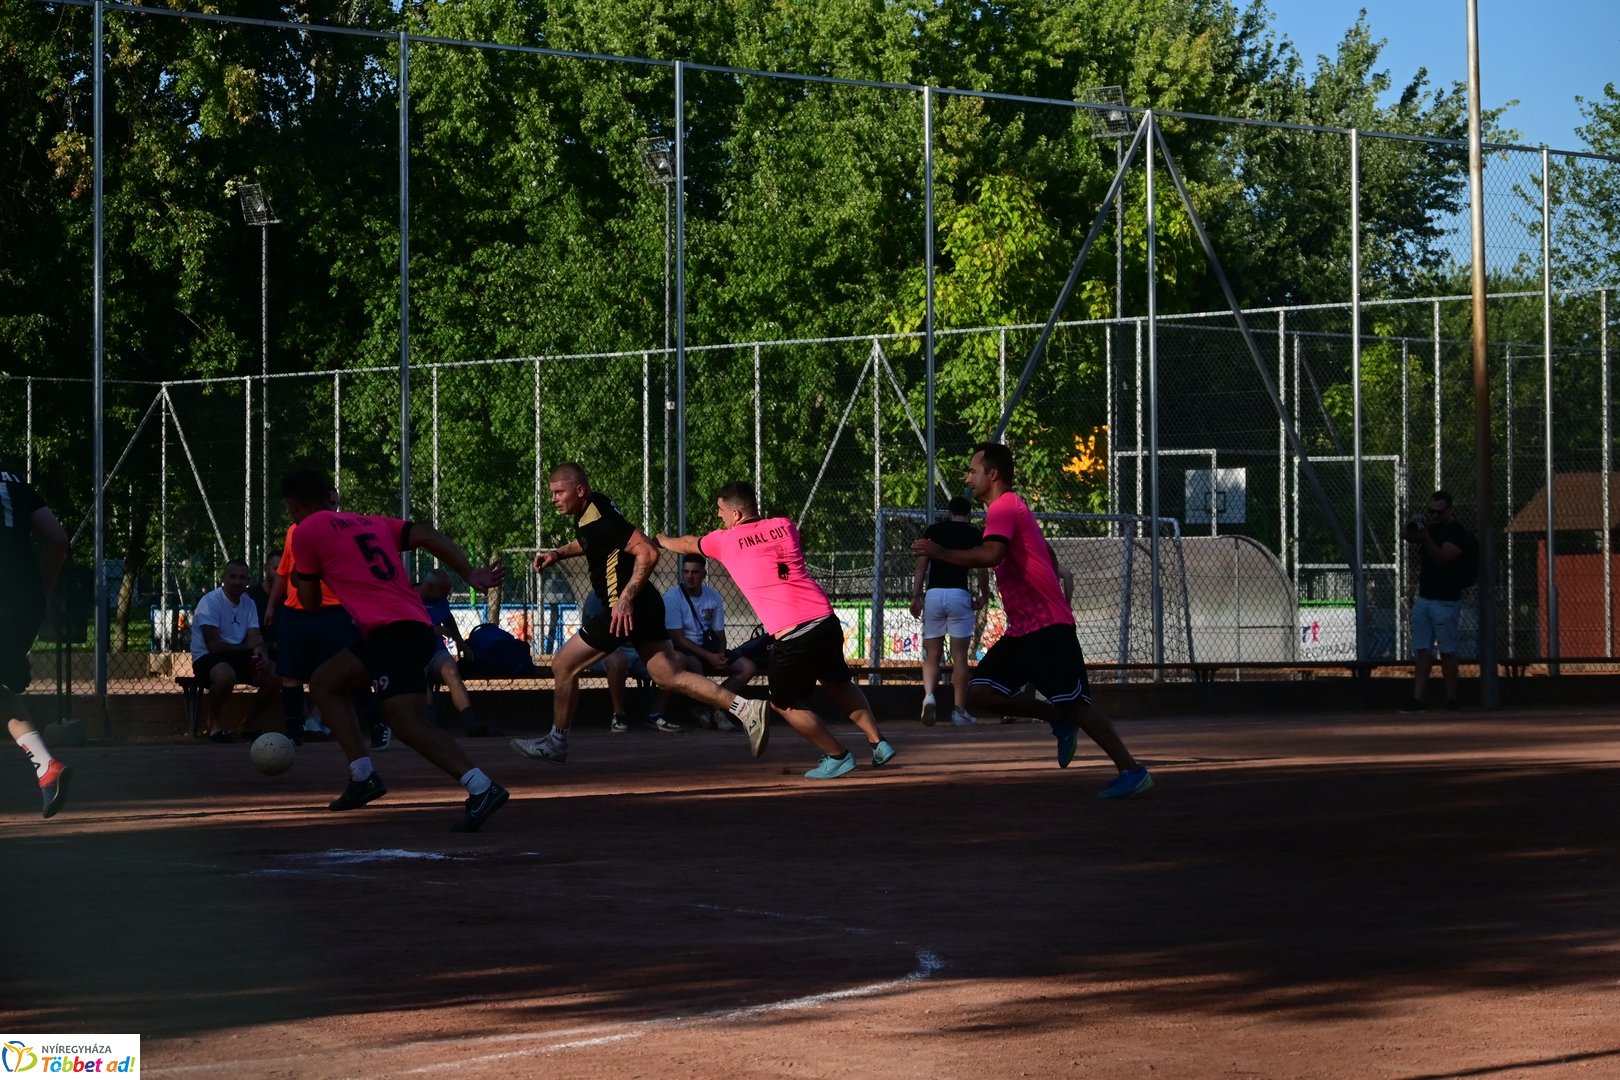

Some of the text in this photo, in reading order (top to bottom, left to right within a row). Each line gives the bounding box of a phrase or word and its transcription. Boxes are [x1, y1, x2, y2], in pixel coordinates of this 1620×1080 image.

[738, 525, 789, 549] FINAL CUT
[354, 533, 396, 580] 5
